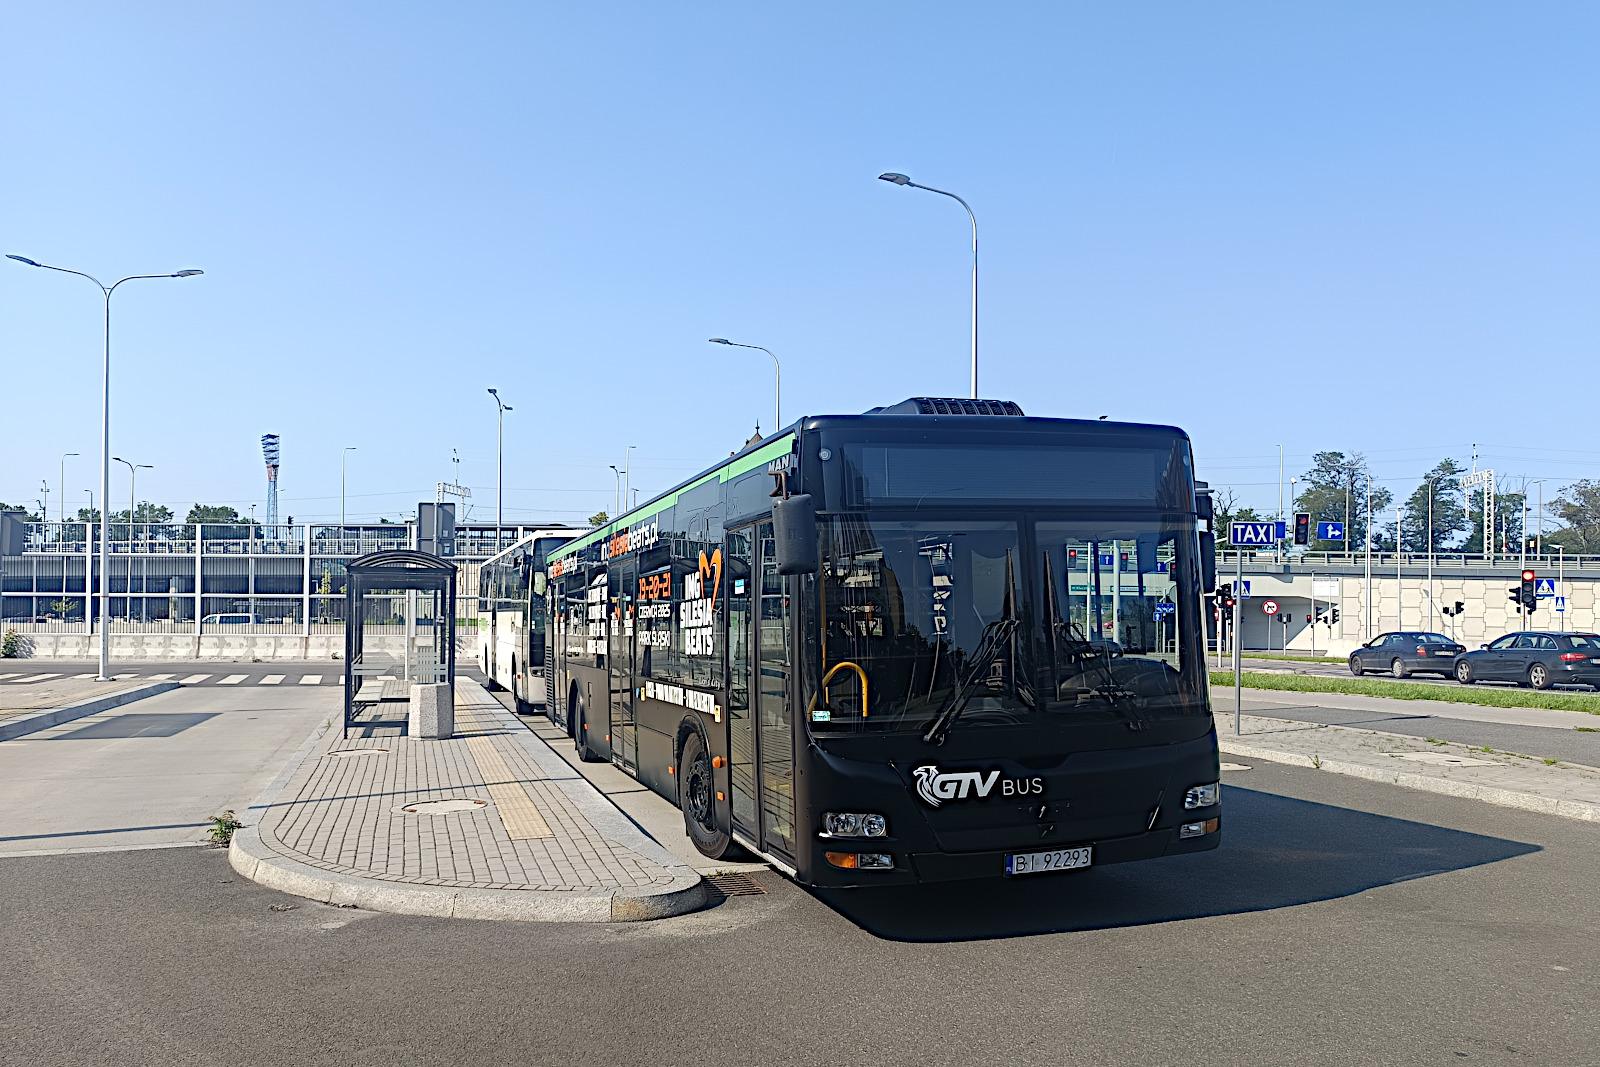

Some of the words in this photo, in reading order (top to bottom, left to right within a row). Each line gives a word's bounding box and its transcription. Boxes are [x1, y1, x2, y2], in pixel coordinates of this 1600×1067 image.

[768, 454, 790, 472] MAN
[1233, 524, 1274, 543] TAXI
[639, 572, 671, 600] 19-20-21
[685, 571, 701, 600] ING
[680, 598, 713, 628] SILESIA
[685, 627, 713, 656] BEATS
[932, 770, 1001, 799] GTV
[1002, 777, 1043, 796] BUS
[1043, 848, 1090, 870] 92293
